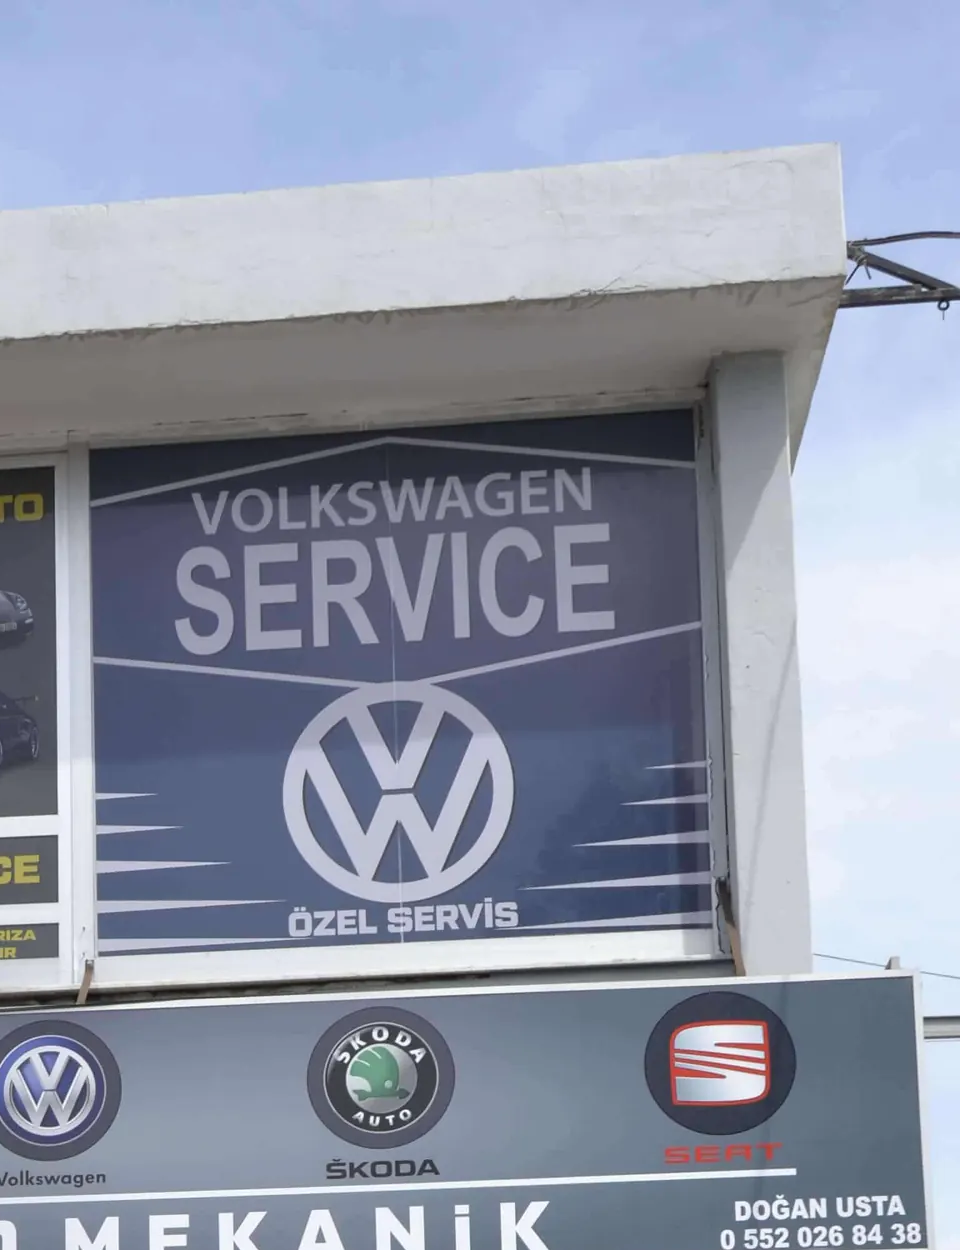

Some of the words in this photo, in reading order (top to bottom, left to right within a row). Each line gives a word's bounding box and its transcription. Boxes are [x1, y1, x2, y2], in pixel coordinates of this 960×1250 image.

[191, 466, 593, 535] VOLKSWAGEN
[174, 523, 616, 656] SERVICE
[288, 904, 377, 938] ÖZEL
[386, 896, 520, 933] SERVİS
[352, 1109, 412, 1127] AUTO
[664, 1142, 783, 1164] SEAT
[326, 1158, 441, 1180] ŠKODA
[734, 1195, 828, 1222] DOĞAN
[836, 1195, 907, 1218] USTA
[720, 1229, 736, 1250] 0
[744, 1227, 790, 1249] 552
[797, 1225, 844, 1247] 026
[852, 1224, 884, 1245] 84
[890, 1223, 922, 1244] 38
